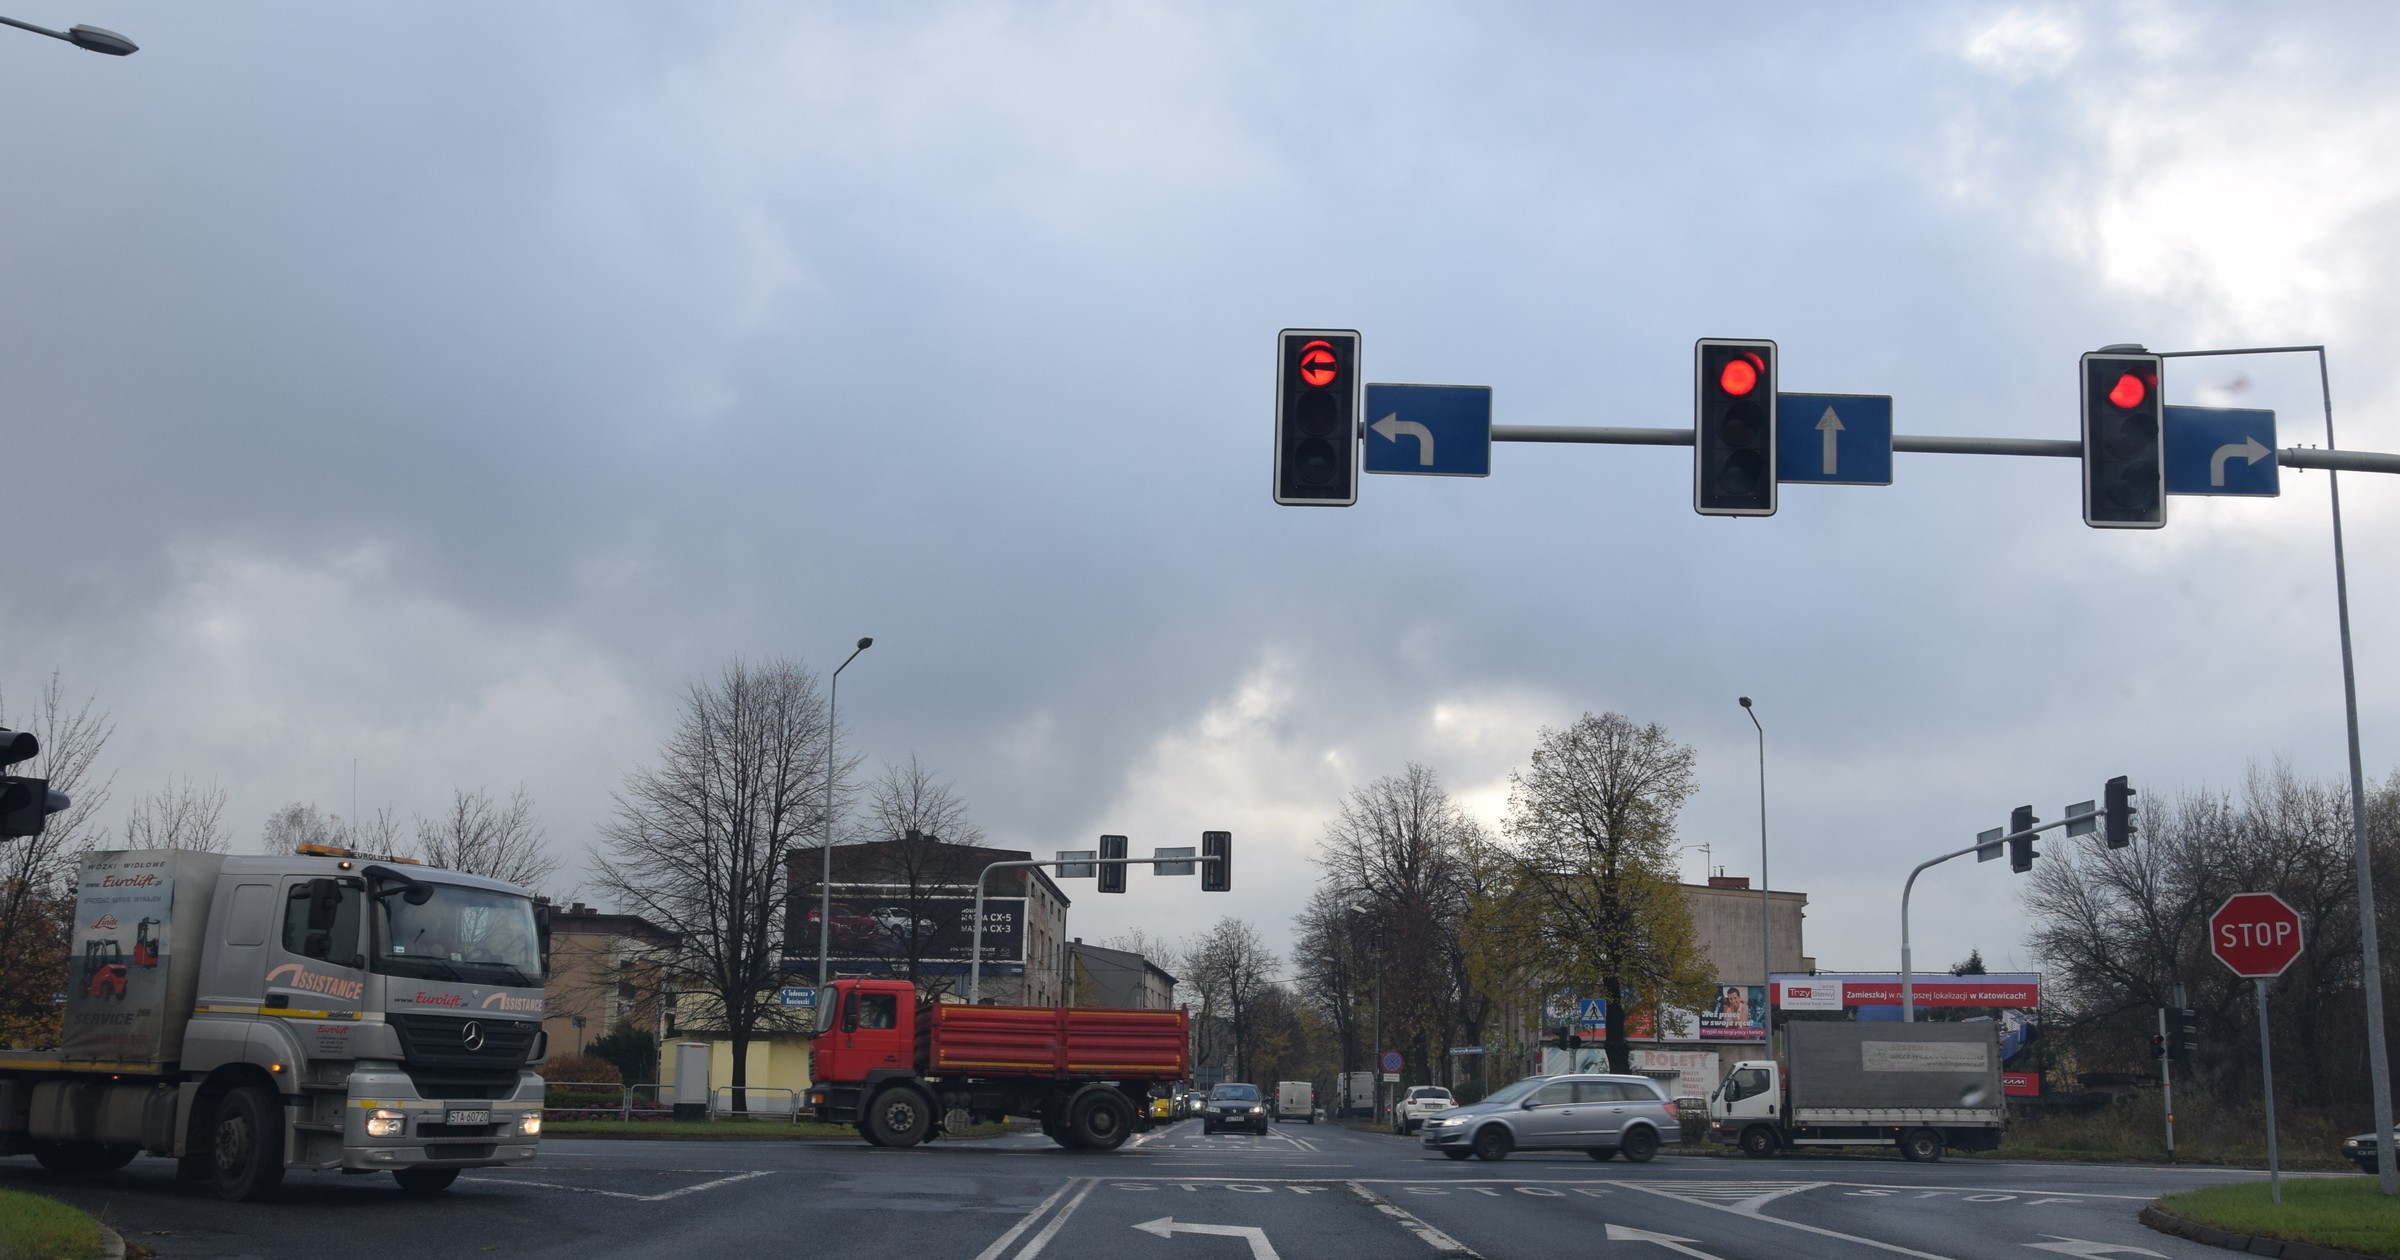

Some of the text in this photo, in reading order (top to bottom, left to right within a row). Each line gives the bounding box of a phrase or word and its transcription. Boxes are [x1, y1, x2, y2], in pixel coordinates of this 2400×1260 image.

[353, 851, 390, 862] EUROLIFT
[91, 914, 118, 930] Linde
[990, 913, 1012, 922] CX-5
[990, 925, 1011, 933] CX-3
[2221, 922, 2292, 948] STOP
[265, 963, 364, 1001] ASSISTANCE
[1789, 988, 1811, 998] Trzy
[1846, 990, 1888, 1001] Zamieszkaj
[1933, 991, 1968, 1002] lokalizacji
[1978, 991, 2028, 1001] Katowicach!
[481, 992, 543, 1013] ASSISTANCE
[74, 1012, 134, 1026] SERVICE
[1718, 1012, 1741, 1020] pracę
[317, 1023, 350, 1036] Eurolift
[1710, 1020, 1734, 1028] swoje
[1645, 1050, 1709, 1067] ROLETY
[451, 1111, 489, 1122] STA 60720
[1109, 1182, 1329, 1195] STOP
[1402, 1186, 1614, 1198] STOP
[1843, 1189, 2084, 1205] STOP
